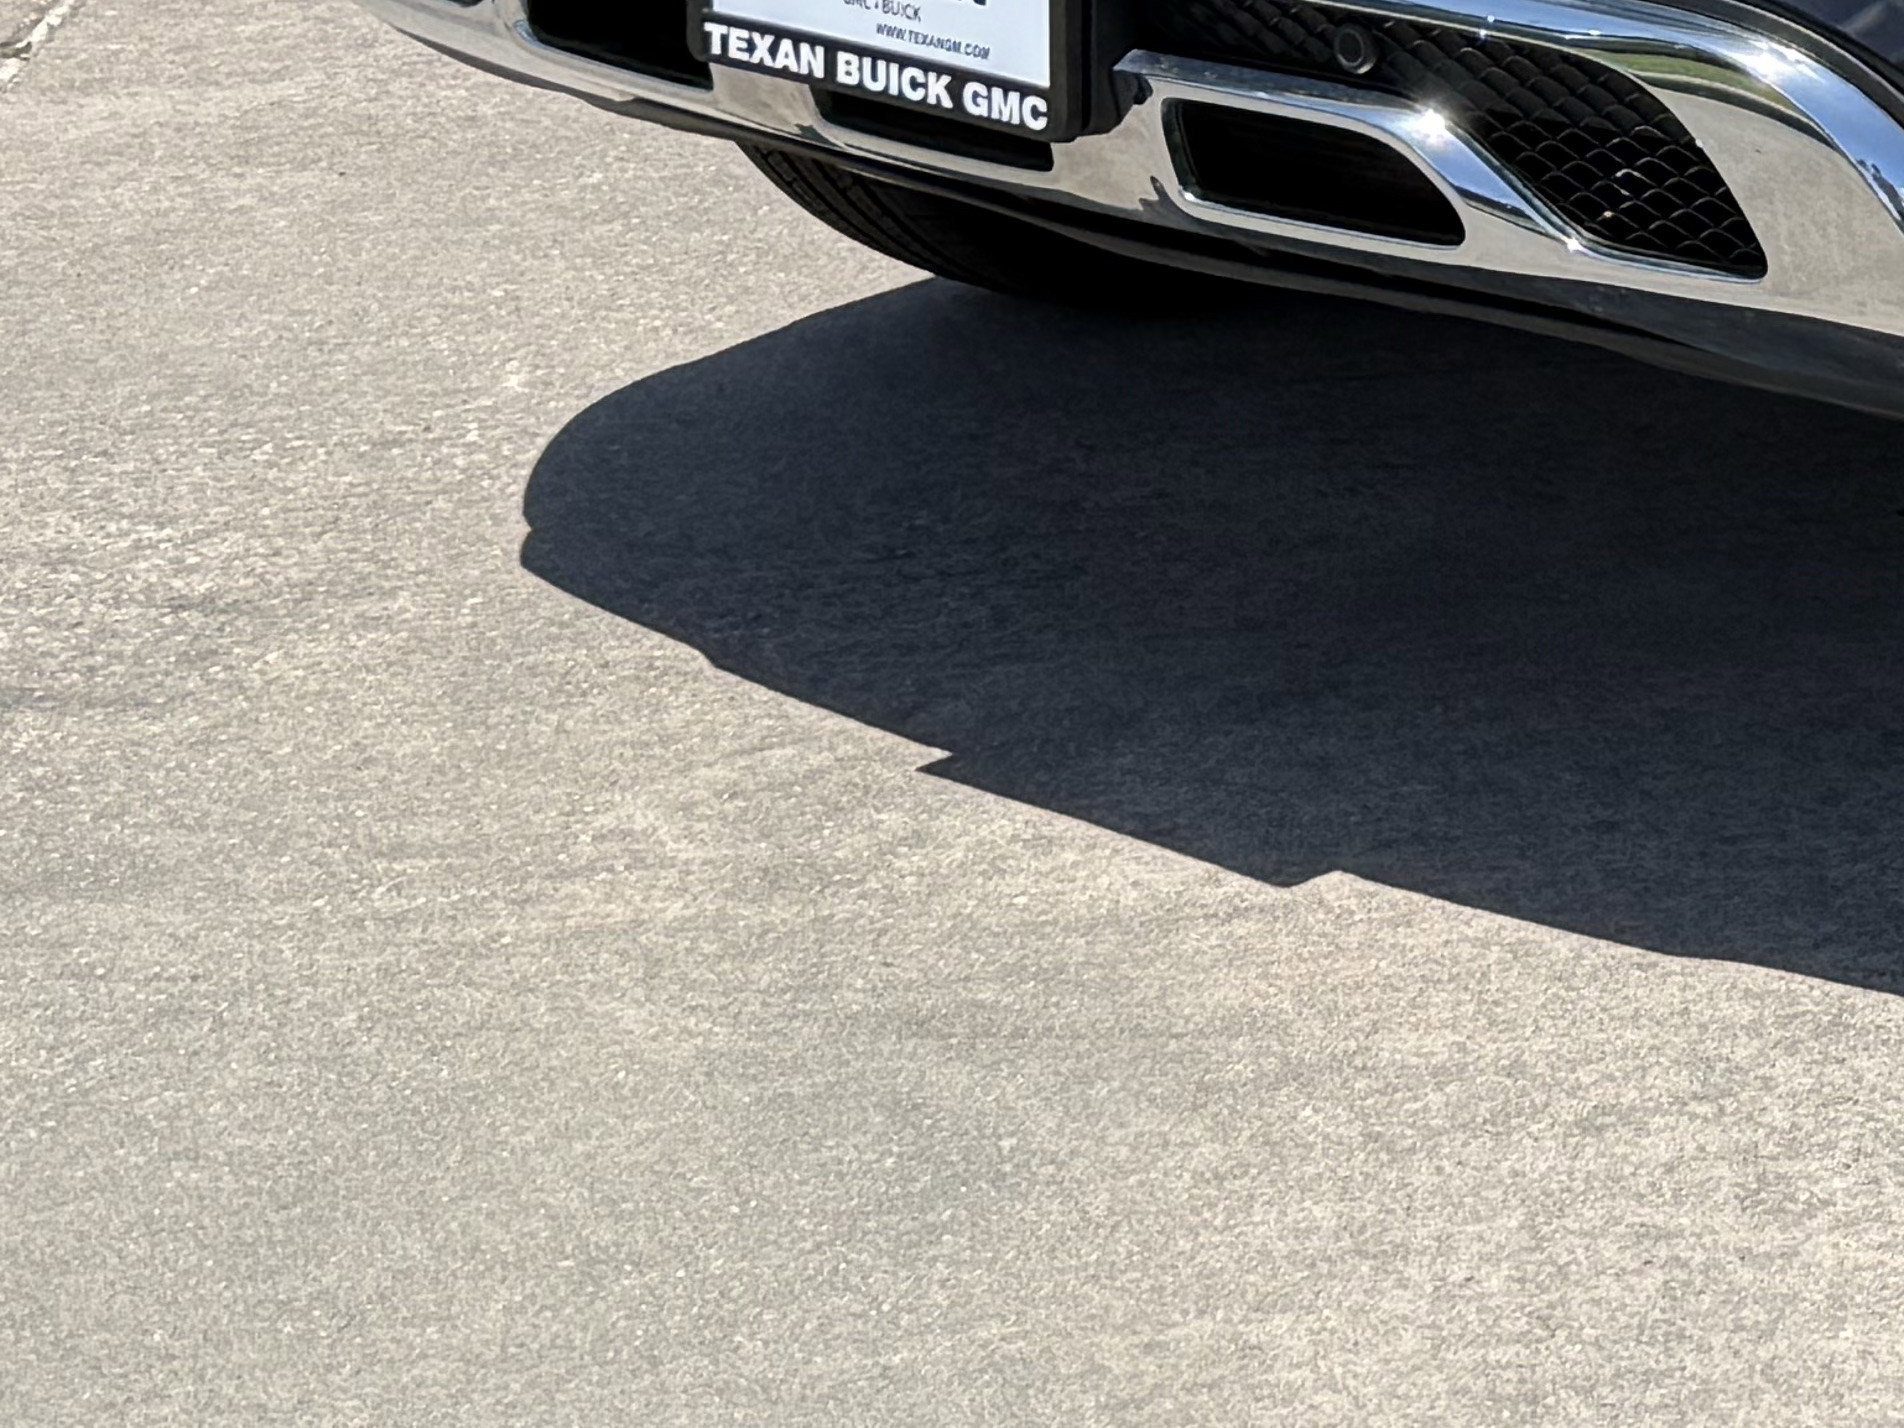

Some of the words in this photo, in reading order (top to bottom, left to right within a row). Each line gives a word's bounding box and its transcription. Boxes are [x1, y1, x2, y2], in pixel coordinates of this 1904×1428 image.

[704, 22, 825, 79] TEXAN
[836, 50, 954, 109] BUICK
[962, 81, 1048, 131] GMC
